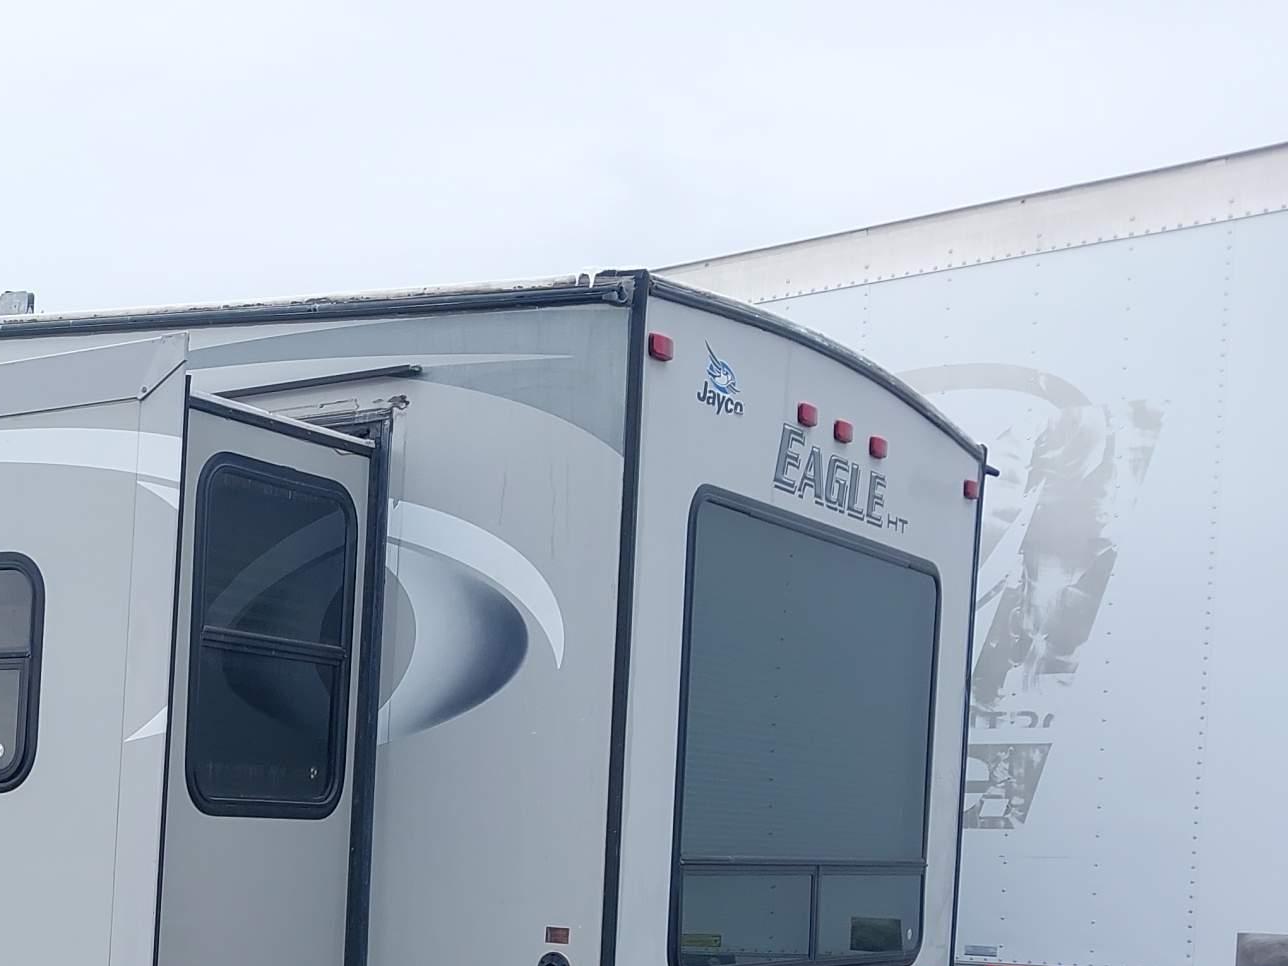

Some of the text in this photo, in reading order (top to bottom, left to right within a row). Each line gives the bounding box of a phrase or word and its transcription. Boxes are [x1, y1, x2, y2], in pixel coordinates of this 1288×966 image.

[697, 381, 743, 415] Jayco
[773, 423, 908, 533] EAGLE HT
